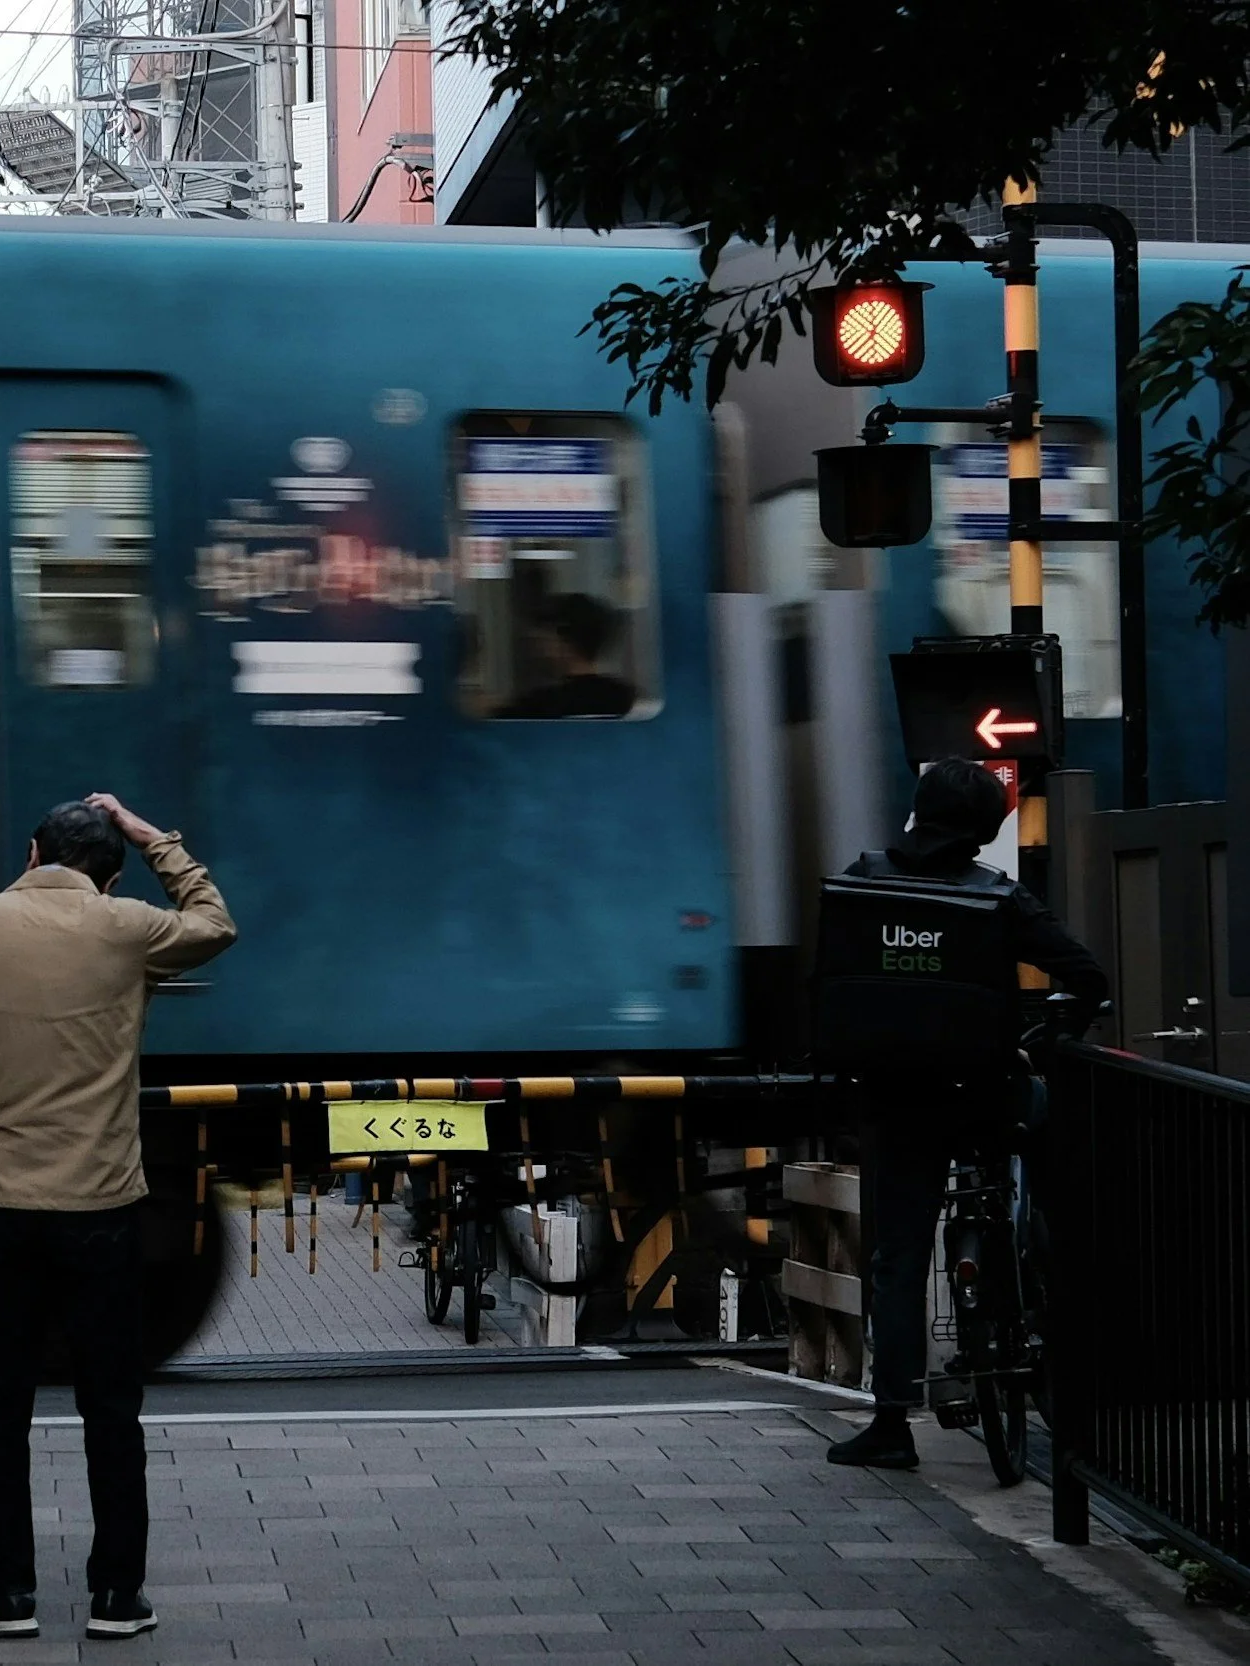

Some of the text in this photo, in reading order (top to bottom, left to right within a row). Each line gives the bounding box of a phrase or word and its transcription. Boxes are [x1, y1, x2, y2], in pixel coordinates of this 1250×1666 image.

[882, 925, 943, 947] Uber
[882, 950, 942, 971] Eats
[364, 1117, 456, 1139] くぐるな
